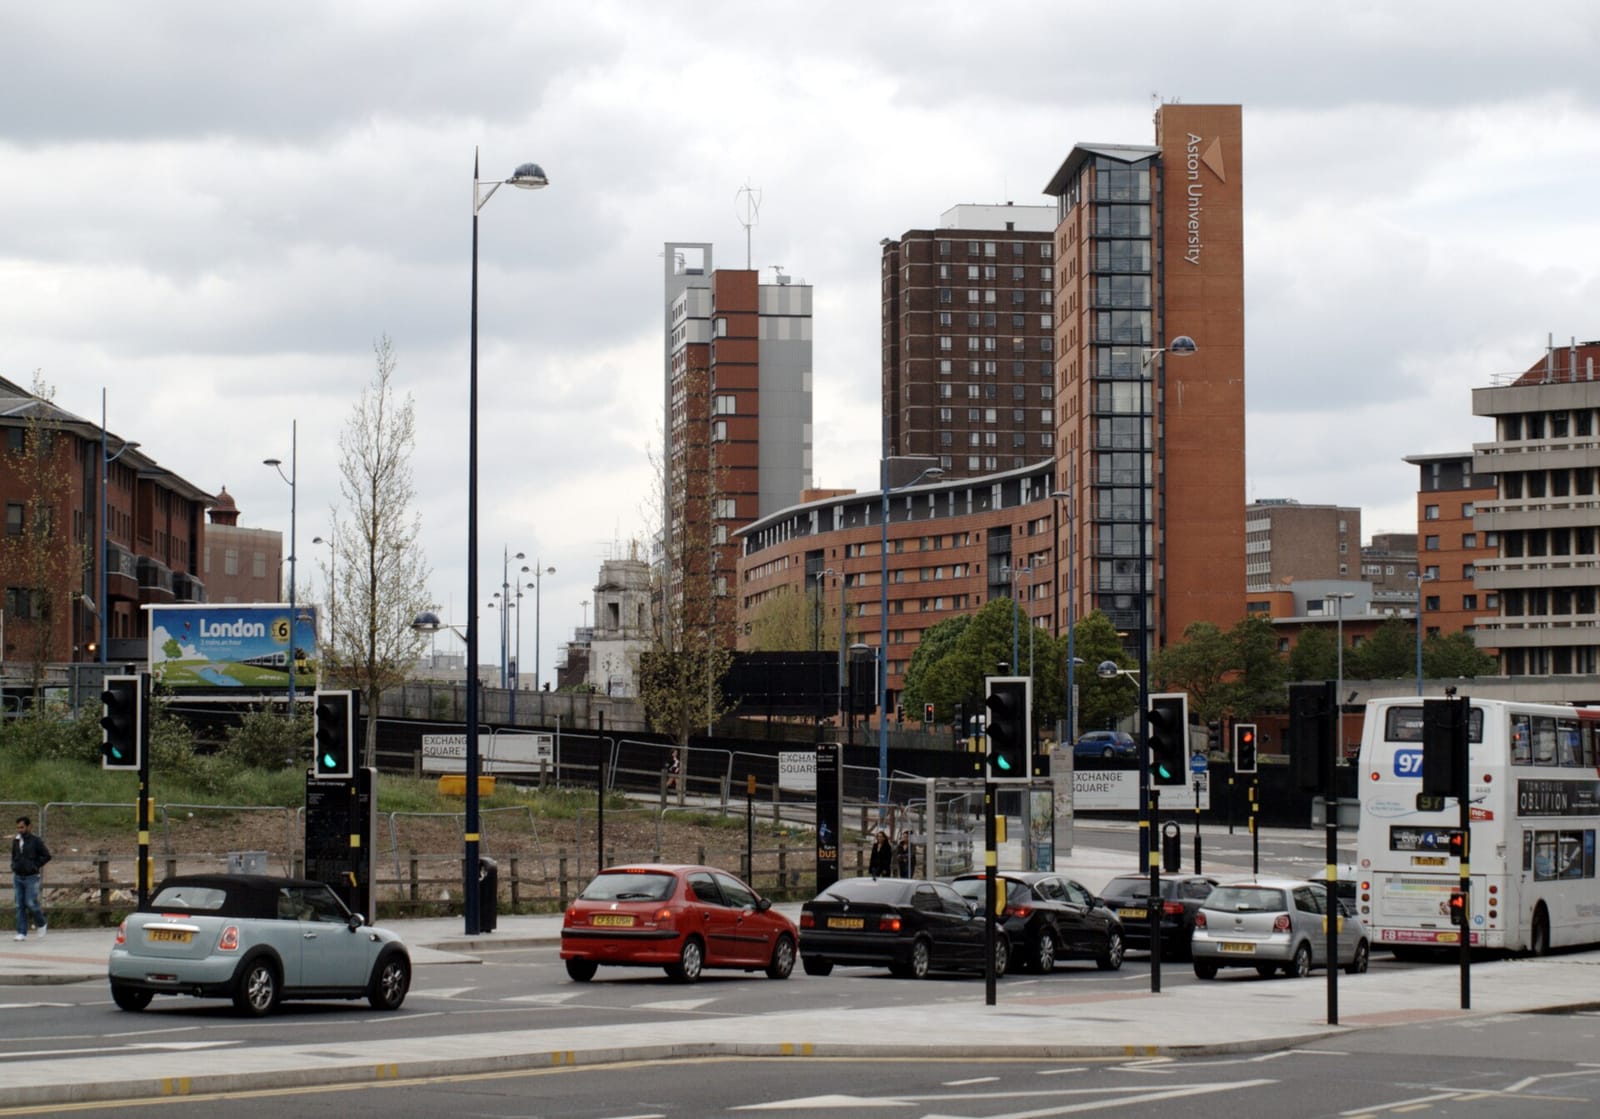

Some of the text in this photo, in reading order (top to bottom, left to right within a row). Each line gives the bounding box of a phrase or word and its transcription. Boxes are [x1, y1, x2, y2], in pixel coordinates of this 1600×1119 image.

[1184, 132, 1203, 265] Aston University
[200, 618, 265, 638] London
[424, 736, 467, 745] EXCHANG
[424, 746, 461, 755] SQUARE
[780, 753, 816, 763] EXCHAN
[1399, 754, 1423, 773] 97
[1421, 797, 1441, 809] 97
[1520, 792, 1568, 810] OBLIVION
[819, 848, 836, 858] bus
